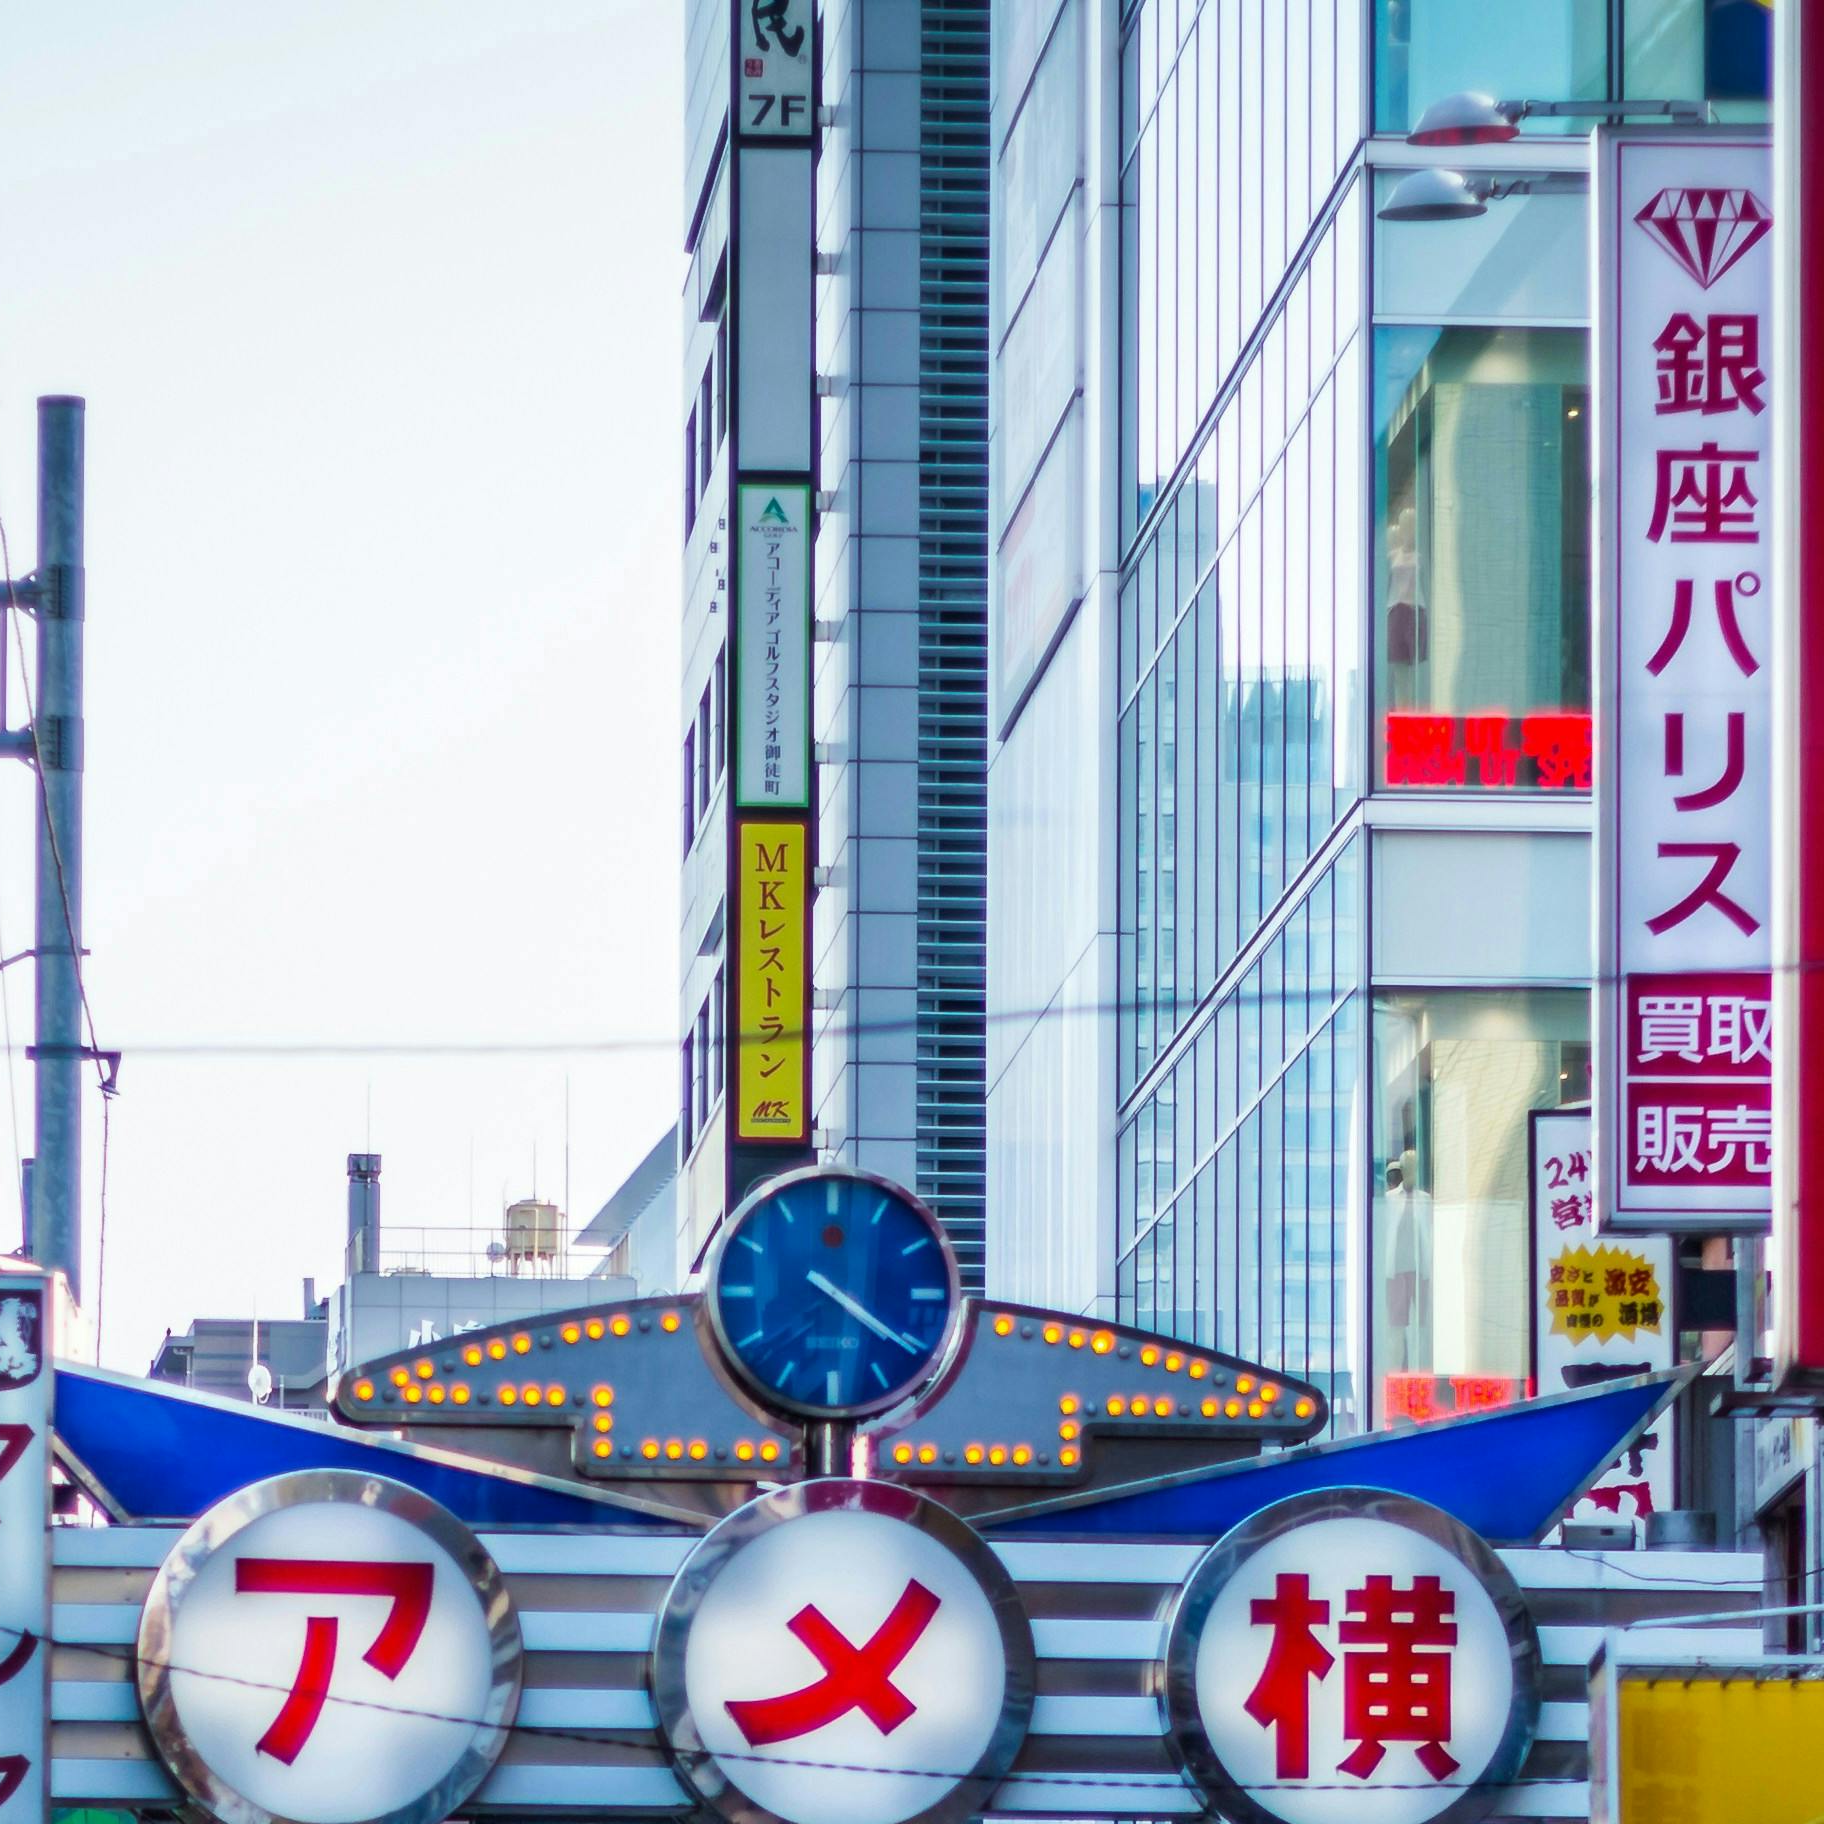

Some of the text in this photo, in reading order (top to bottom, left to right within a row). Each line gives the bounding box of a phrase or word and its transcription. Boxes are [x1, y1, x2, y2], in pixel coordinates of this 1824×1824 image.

[748, 94, 806, 126] 7F
[1646, 312, 1767, 937] 銀座パリス
[754, 843, 789, 1079] MKレストラン
[1637, 996, 1773, 1066] 買取
[1635, 1103, 1773, 1174] 販売
[1550, 1191, 1592, 1231] 営
